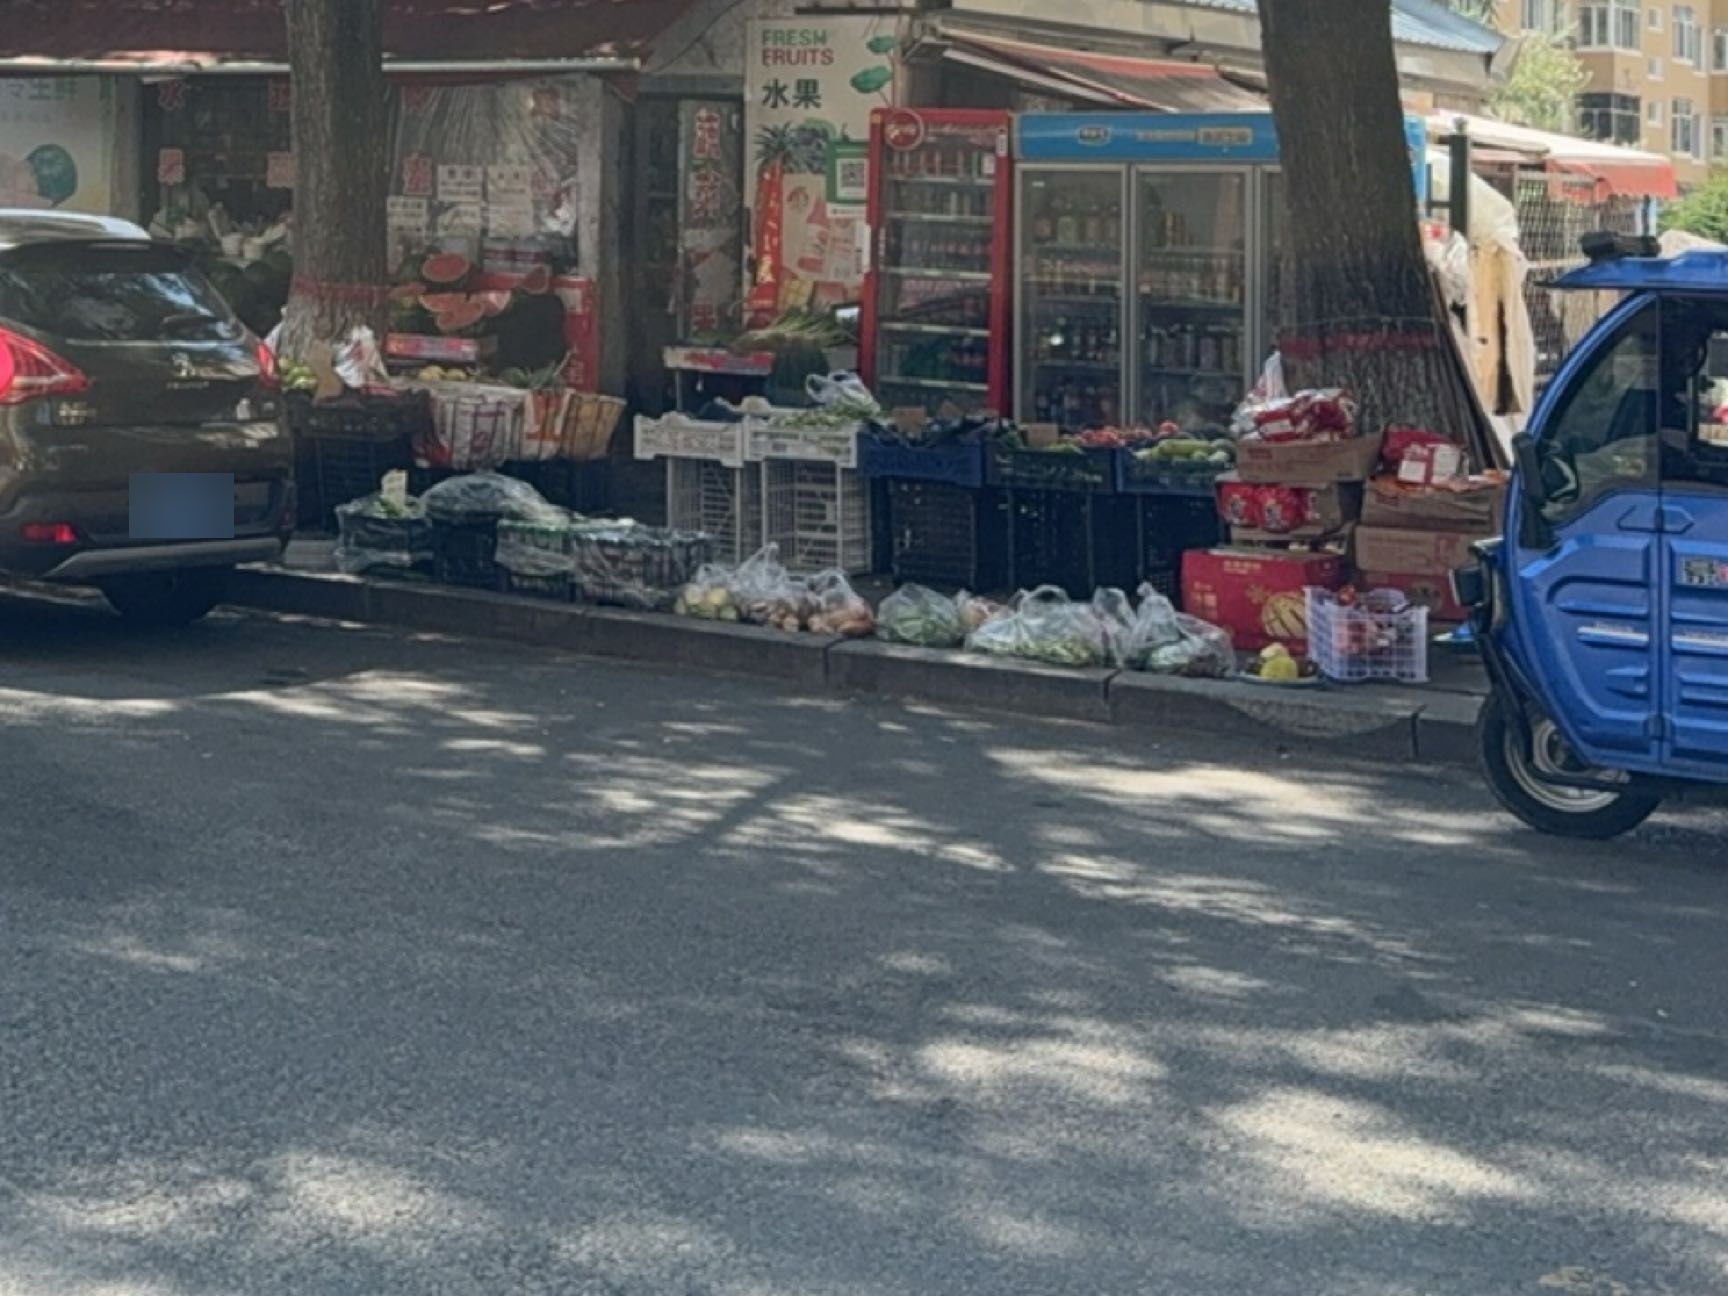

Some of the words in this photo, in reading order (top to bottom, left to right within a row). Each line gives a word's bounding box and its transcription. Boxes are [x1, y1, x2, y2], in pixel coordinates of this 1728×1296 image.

[762, 29, 828, 46] FRESH
[762, 48, 834, 66] FRUITS
[761, 78, 822, 109] 水果
